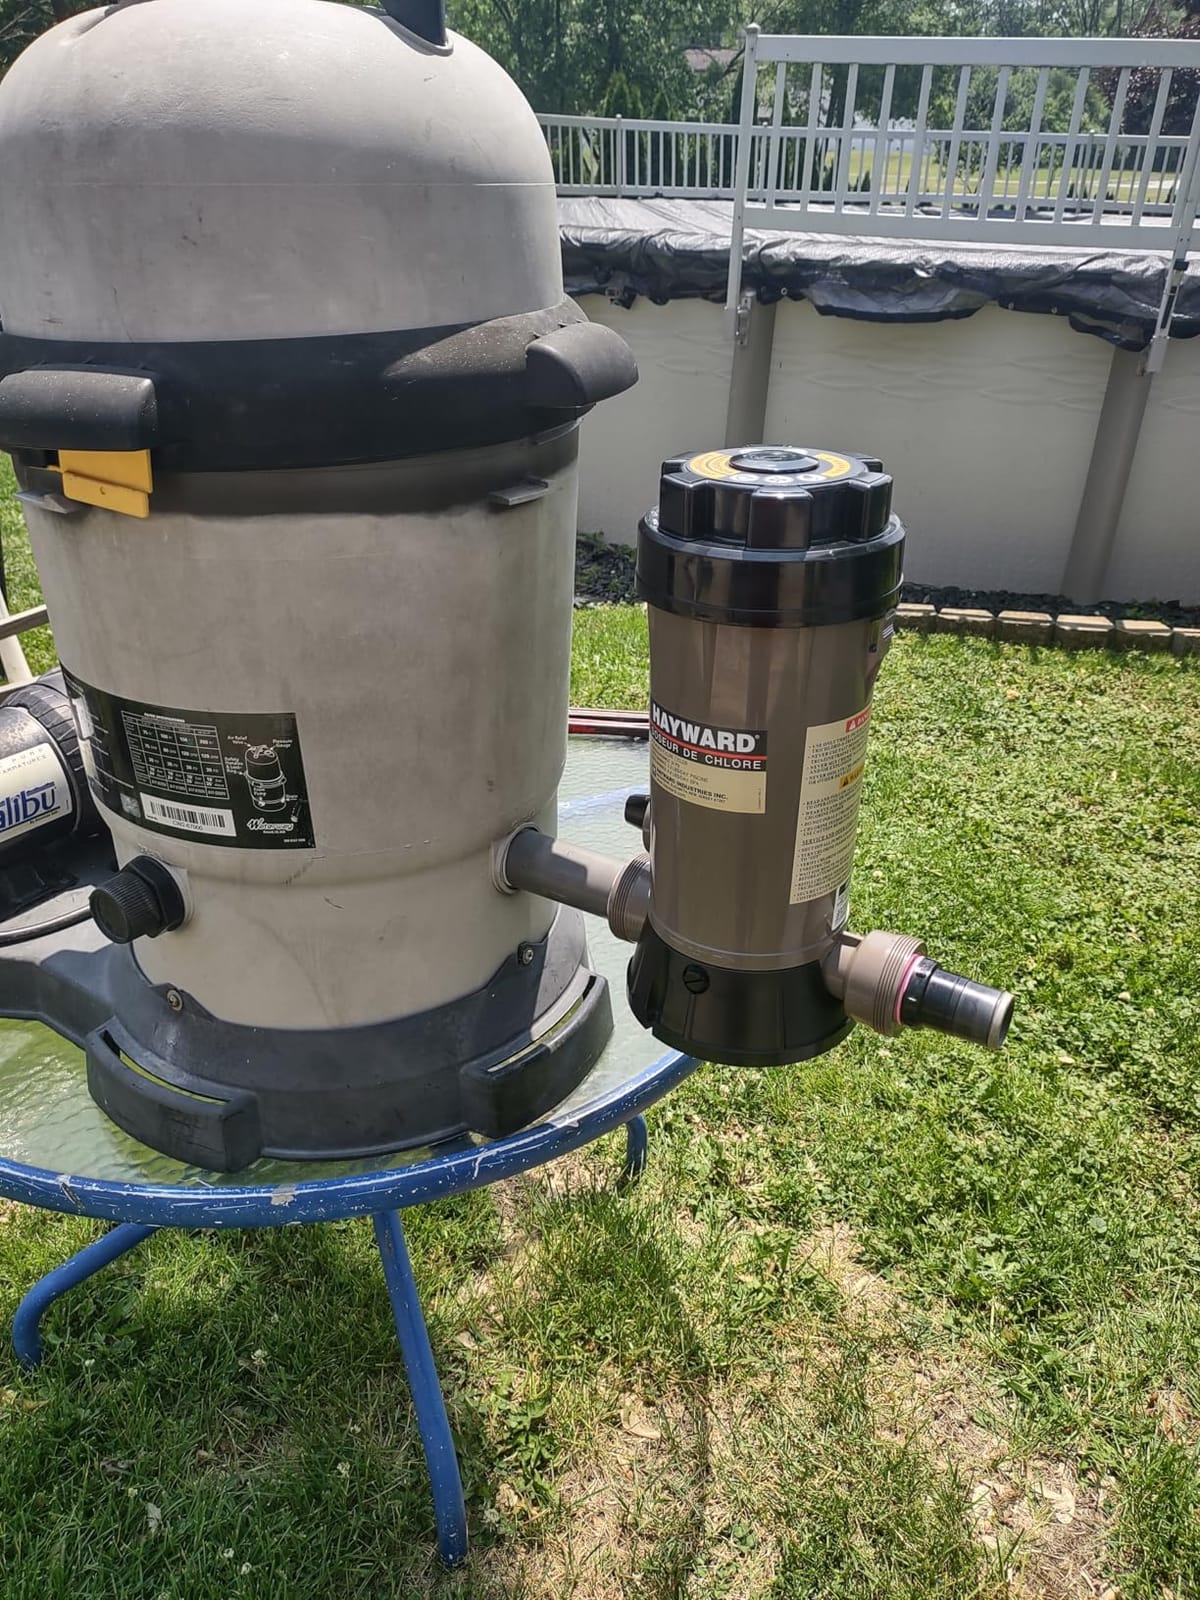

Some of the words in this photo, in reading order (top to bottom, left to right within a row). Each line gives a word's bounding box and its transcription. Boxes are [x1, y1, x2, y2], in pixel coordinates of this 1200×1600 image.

[652, 703, 756, 753] HAYWARD
[683, 748, 698, 760] DE
[705, 754, 761, 770] CHLORE
